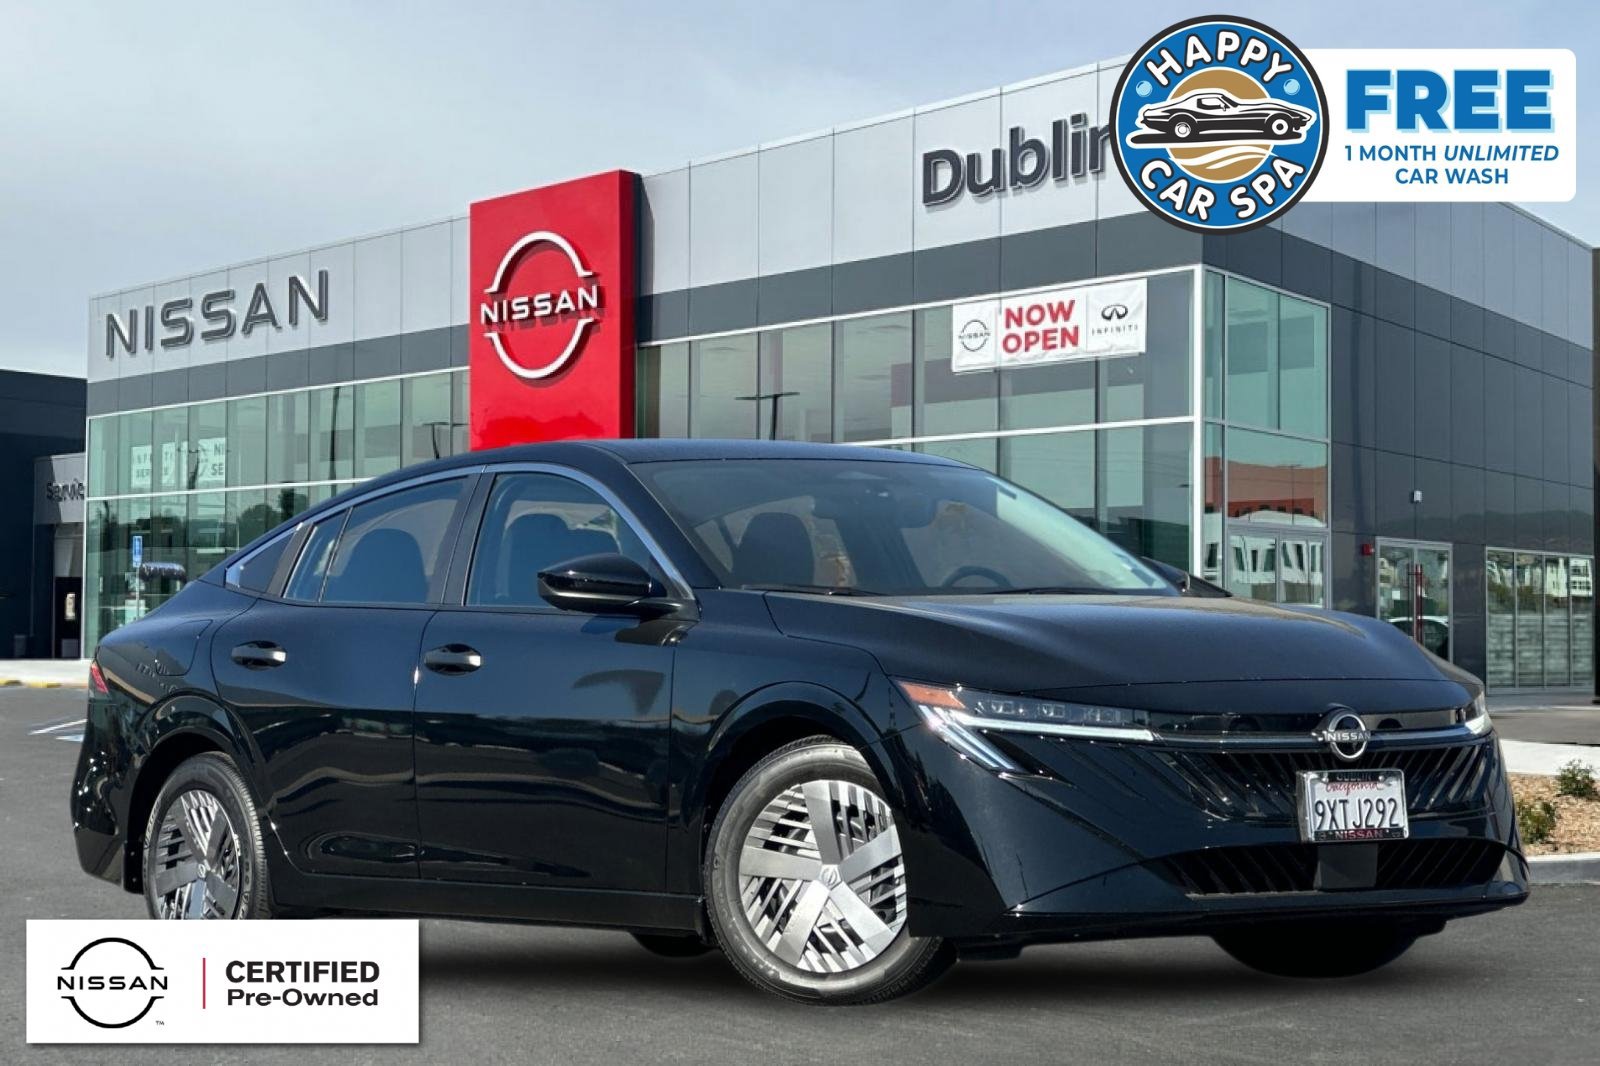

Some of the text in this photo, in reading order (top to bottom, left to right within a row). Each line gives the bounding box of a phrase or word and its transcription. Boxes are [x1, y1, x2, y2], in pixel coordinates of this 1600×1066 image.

[106, 269, 329, 360] NISSAN
[480, 285, 598, 325] NISSAN
[1004, 300, 1075, 330] NOW
[1002, 325, 1079, 354] OPEN
[1327, 731, 1371, 741] NISSAN
[1314, 797, 1400, 830] 9XTJ292
[1335, 829, 1384, 840] NISSAN
